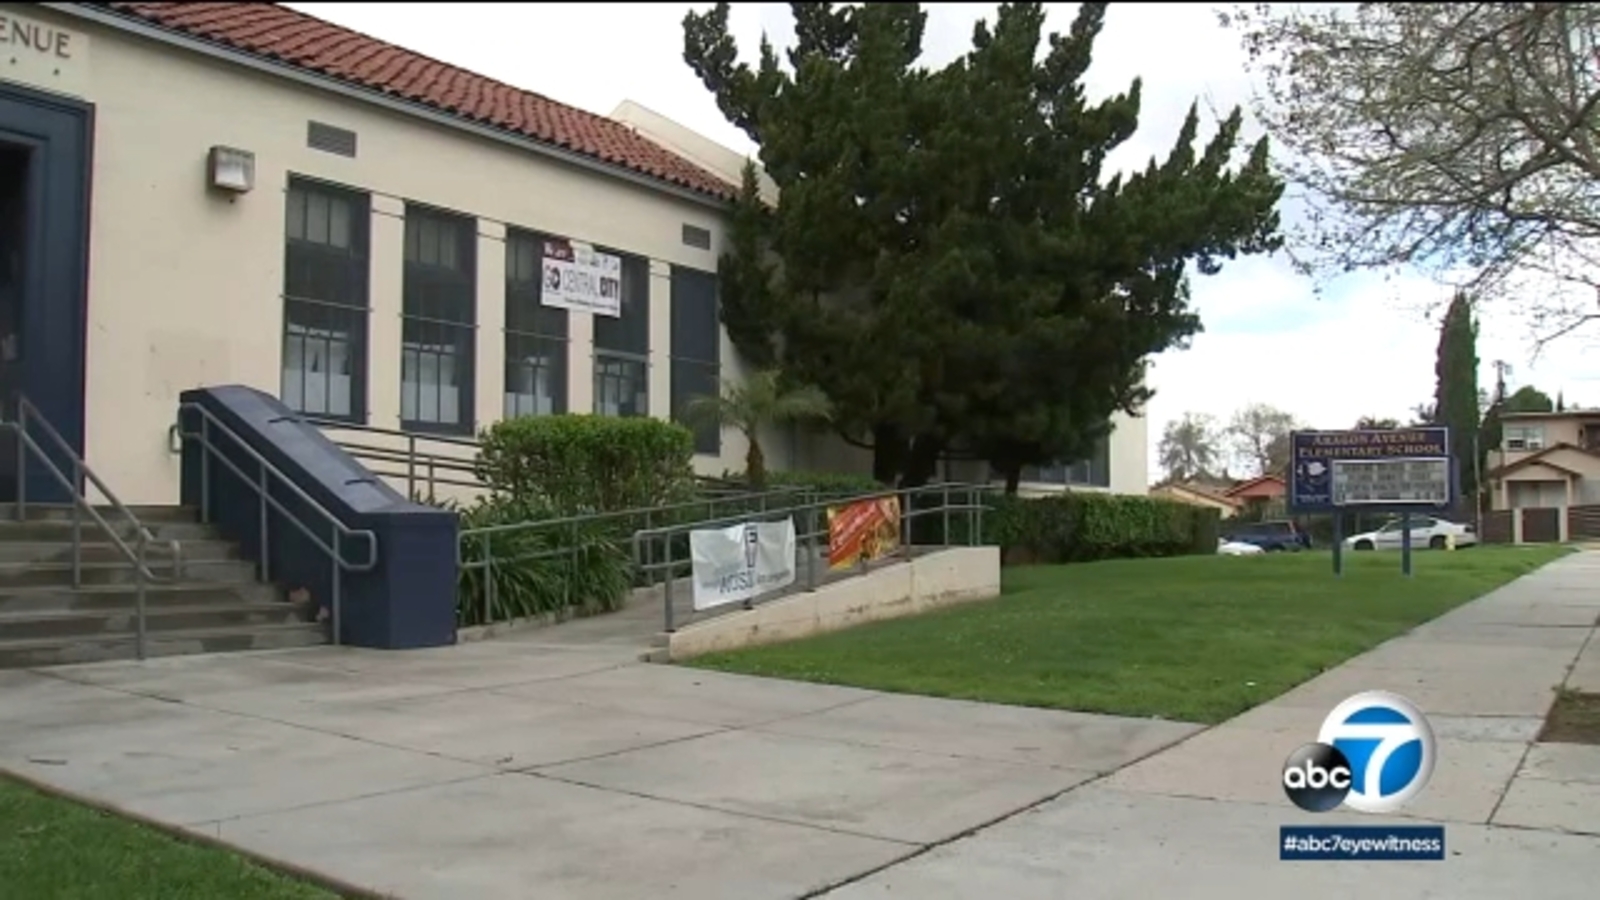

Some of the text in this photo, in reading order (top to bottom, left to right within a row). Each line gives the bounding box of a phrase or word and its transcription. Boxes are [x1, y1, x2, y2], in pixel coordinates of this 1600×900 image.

[563, 269, 599, 298] CENTRAL
[600, 276, 619, 299] CITY
[1370, 432, 1426, 443] AVENUE
[1298, 444, 1443, 456] ELEMENTARY SCHOOL
